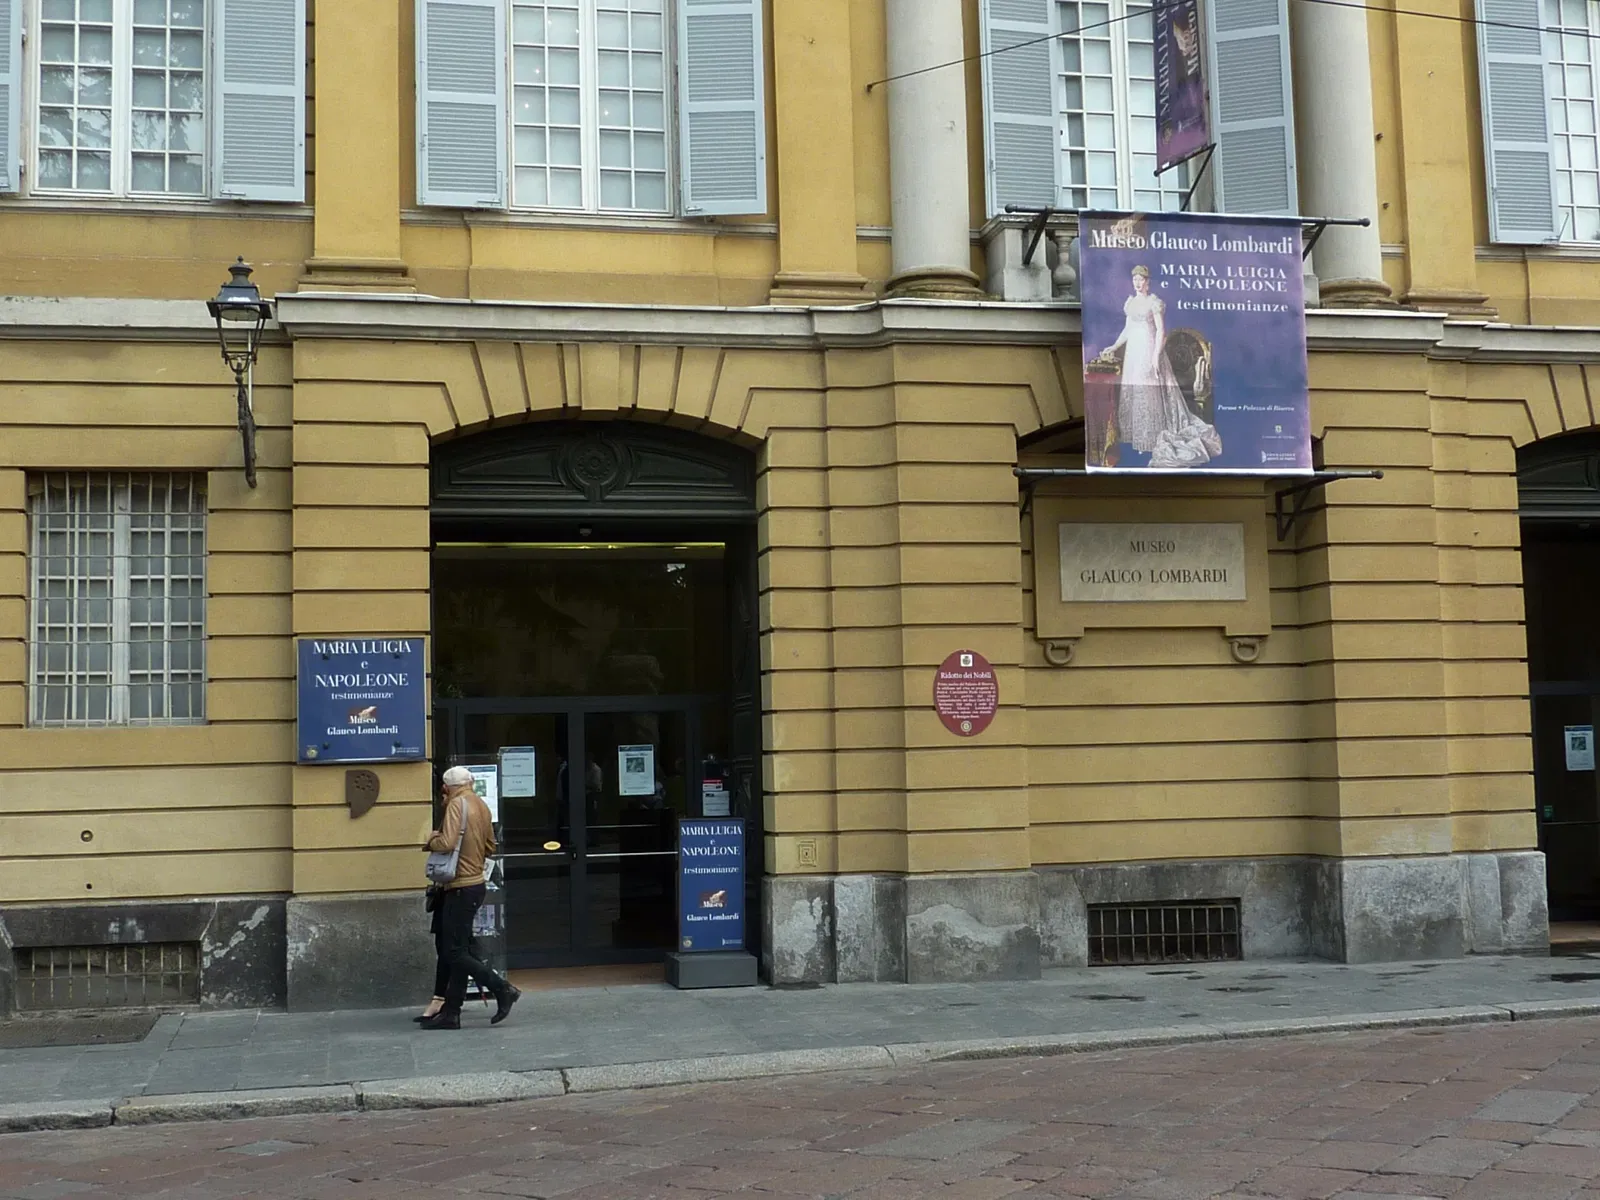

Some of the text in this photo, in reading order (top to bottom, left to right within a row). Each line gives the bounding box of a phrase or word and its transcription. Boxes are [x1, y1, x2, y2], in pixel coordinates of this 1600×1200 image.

[1089, 229, 1293, 254] Museo Glauco Lombardi
[1160, 263, 1287, 279] MARIA LUIGIA
[1160, 277, 1288, 292] e NAPOLEONE
[1177, 299, 1289, 313] testimonianze
[1130, 541, 1176, 553] MUSEO
[1080, 568, 1228, 584] GLAUCO LOMBARDI
[313, 640, 412, 655] MARIA LUIGIA
[360, 660, 369, 669] e
[315, 673, 409, 687] NAPOLEONE
[940, 671, 962, 679] Ridotto
[963, 671, 972, 679] dei
[331, 691, 394, 700] testimonianze
[348, 715, 376, 724] Museo
[327, 725, 398, 735] Glauco Lombardi
[681, 825, 743, 836] MARIA LUIGIA
[682, 846, 740, 857] NAPOLEONE
[684, 866, 739, 875] testimonianze
[702, 900, 723, 908] Museo
[686, 913, 739, 922] Glauco Lombardi
